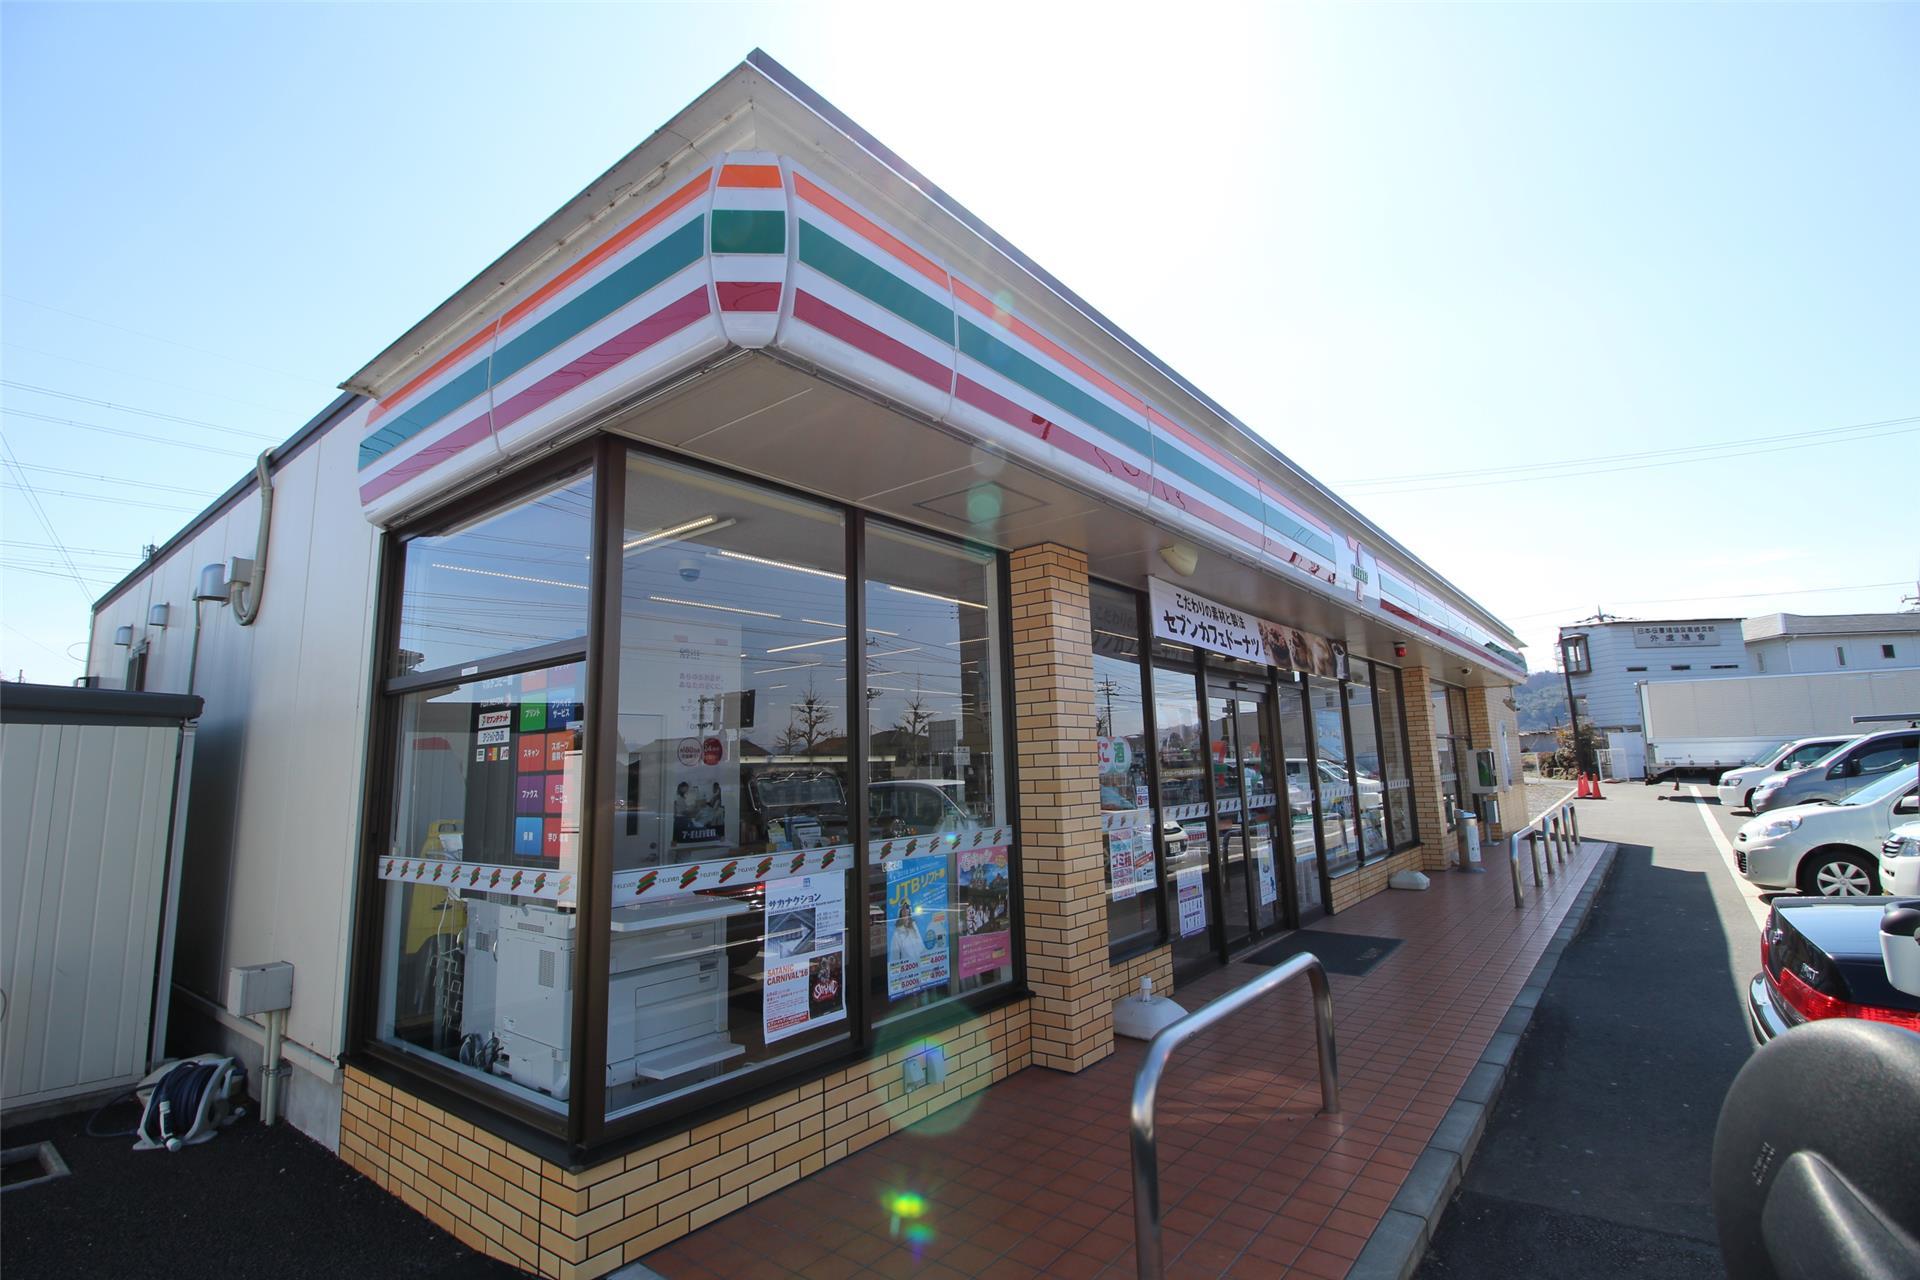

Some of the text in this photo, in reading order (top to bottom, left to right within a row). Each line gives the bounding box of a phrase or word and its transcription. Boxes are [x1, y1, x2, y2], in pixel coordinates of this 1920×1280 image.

[1176, 593, 1246, 630] こだわりの素材と製法
[1163, 609, 1259, 656] セブンカフェドーナツ
[525, 708, 541, 718] プリント
[553, 708, 570, 718] サービス
[524, 749, 540, 757] スキャン
[522, 790, 538, 799] ファクス
[1112, 852, 1132, 868] ゴミ箱
[768, 893, 821, 911] サカナクション
[767, 964, 794, 977] SATANIC
